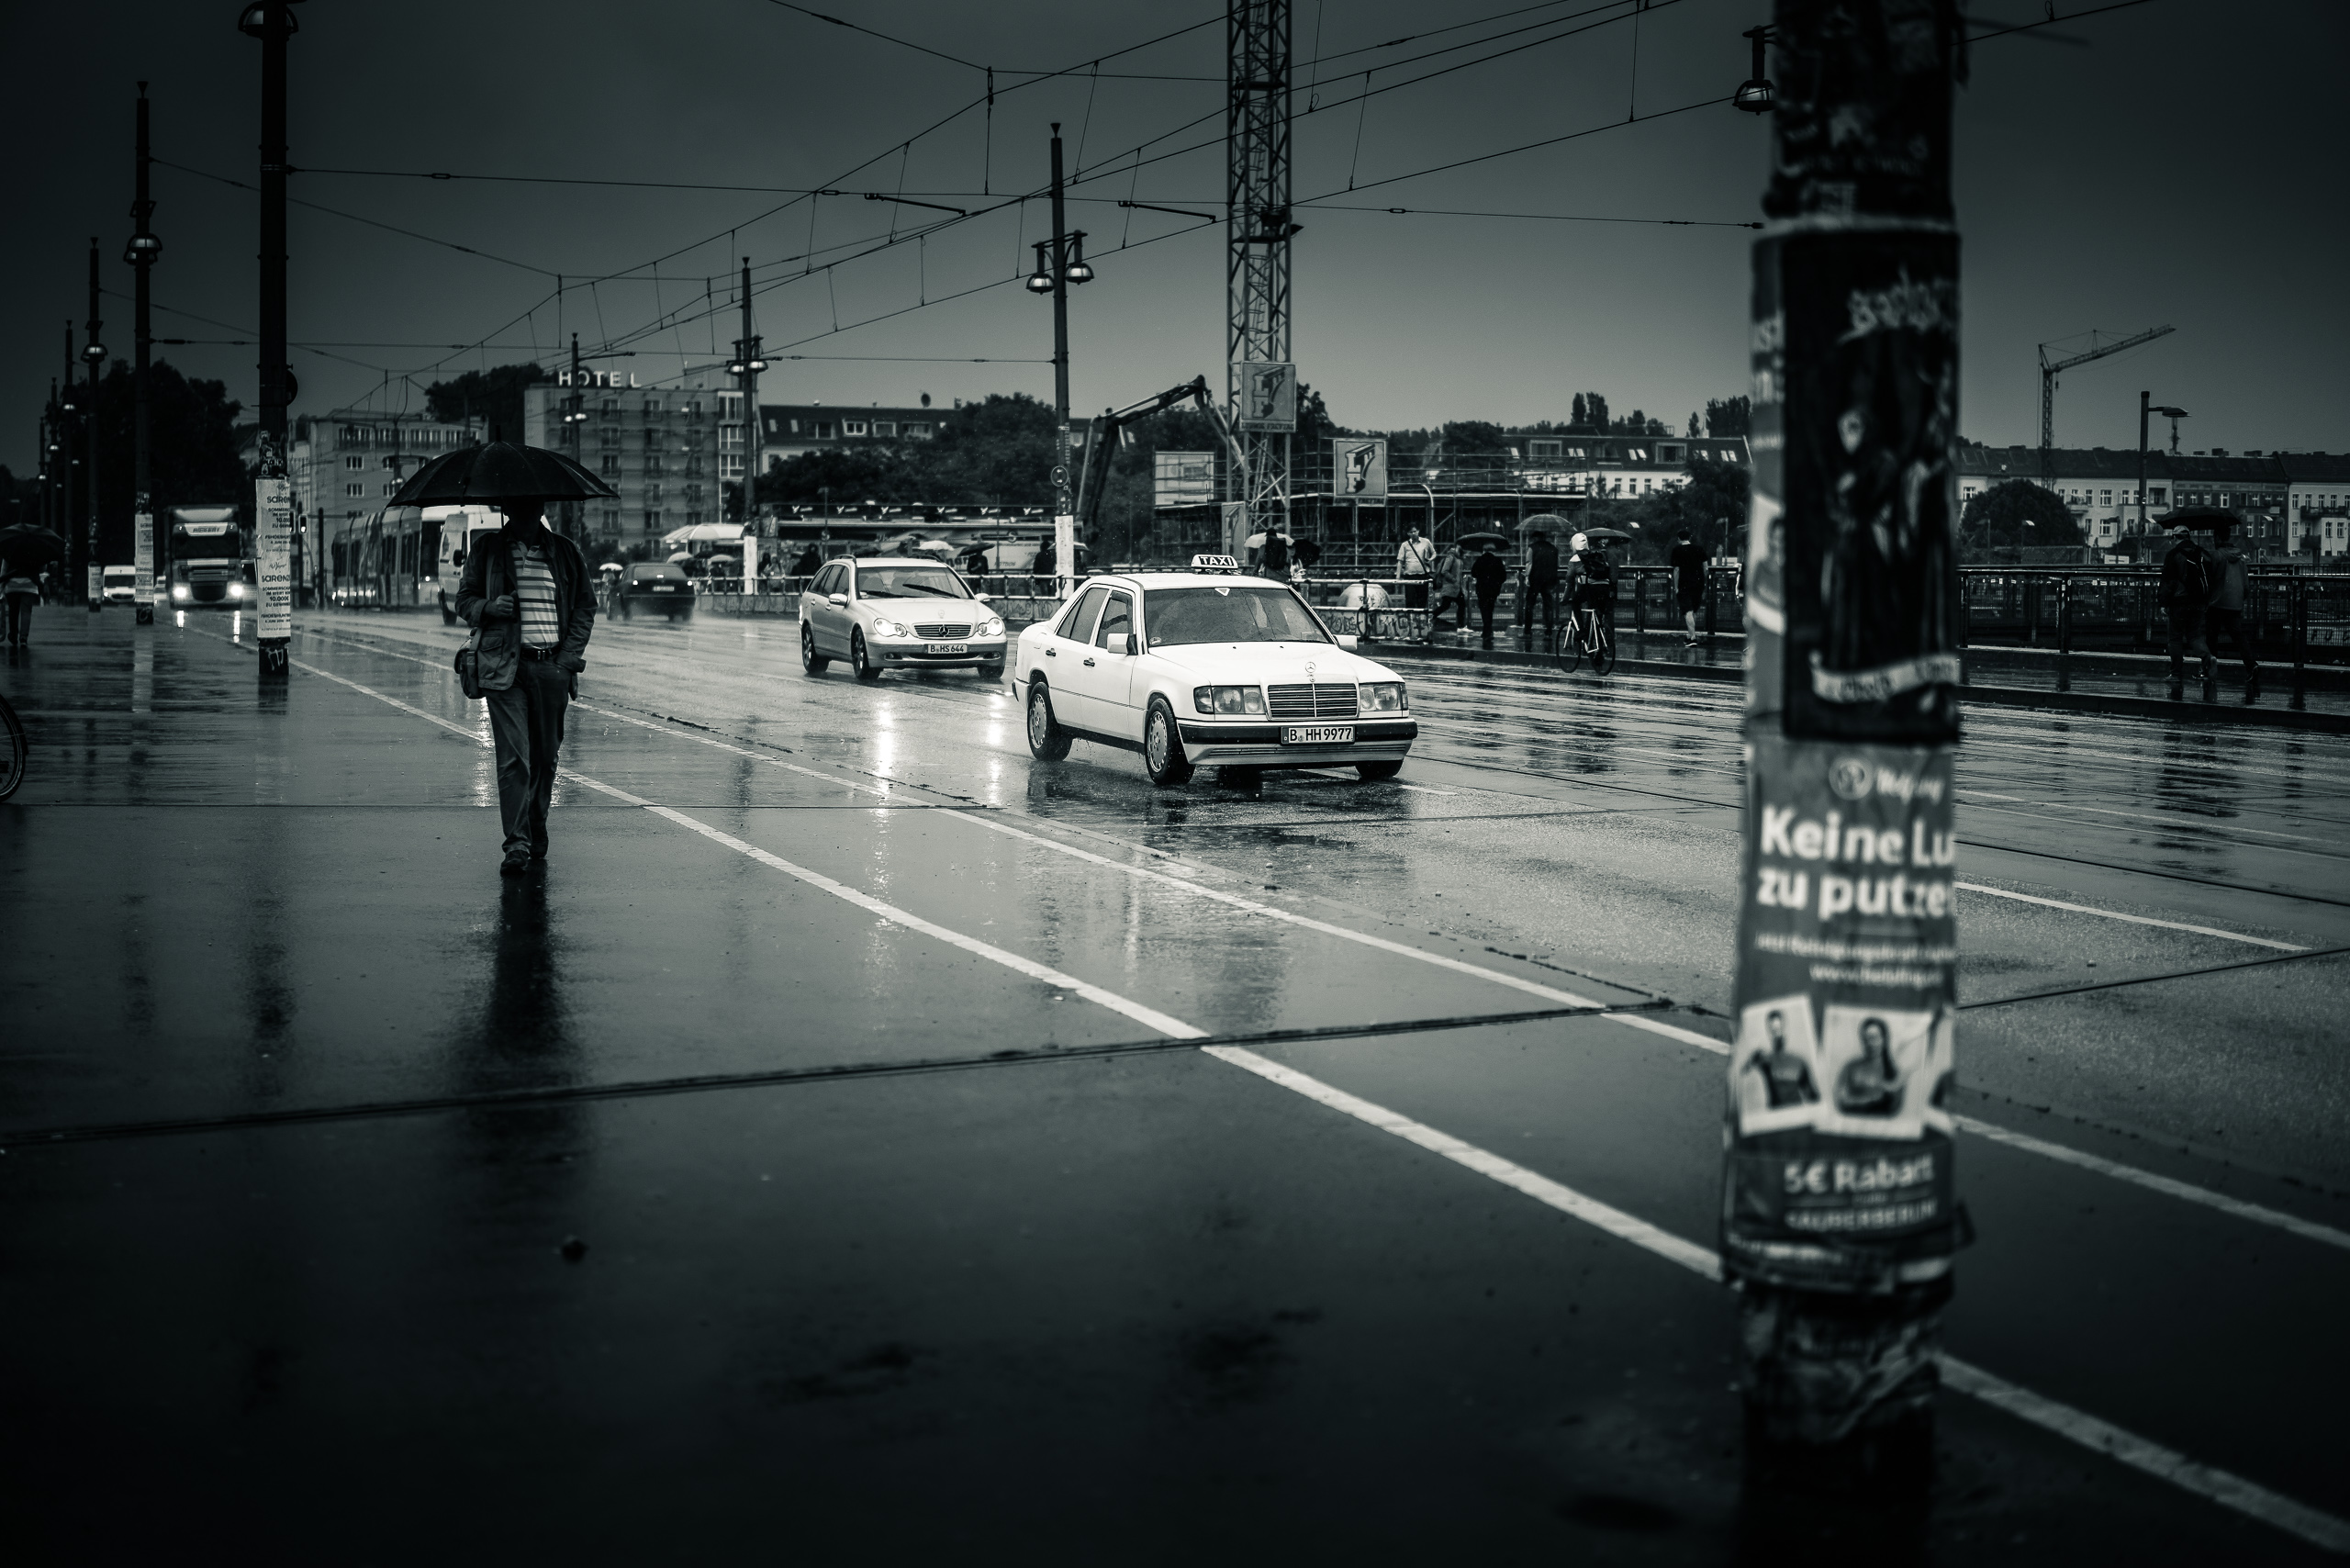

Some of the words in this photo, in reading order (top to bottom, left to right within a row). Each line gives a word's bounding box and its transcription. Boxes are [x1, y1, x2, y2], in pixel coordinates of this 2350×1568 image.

[558, 370, 642, 387] HOTEL
[1200, 556, 1233, 566] TAXI
[1290, 729, 1297, 741] B
[1305, 728, 1322, 741] HH
[1324, 727, 1351, 741] 9977
[1761, 803, 1905, 866] Keine
[1757, 867, 1808, 911] zu
[1818, 873, 1954, 922] putze
[1832, 1152, 1935, 1193] Rabatt
